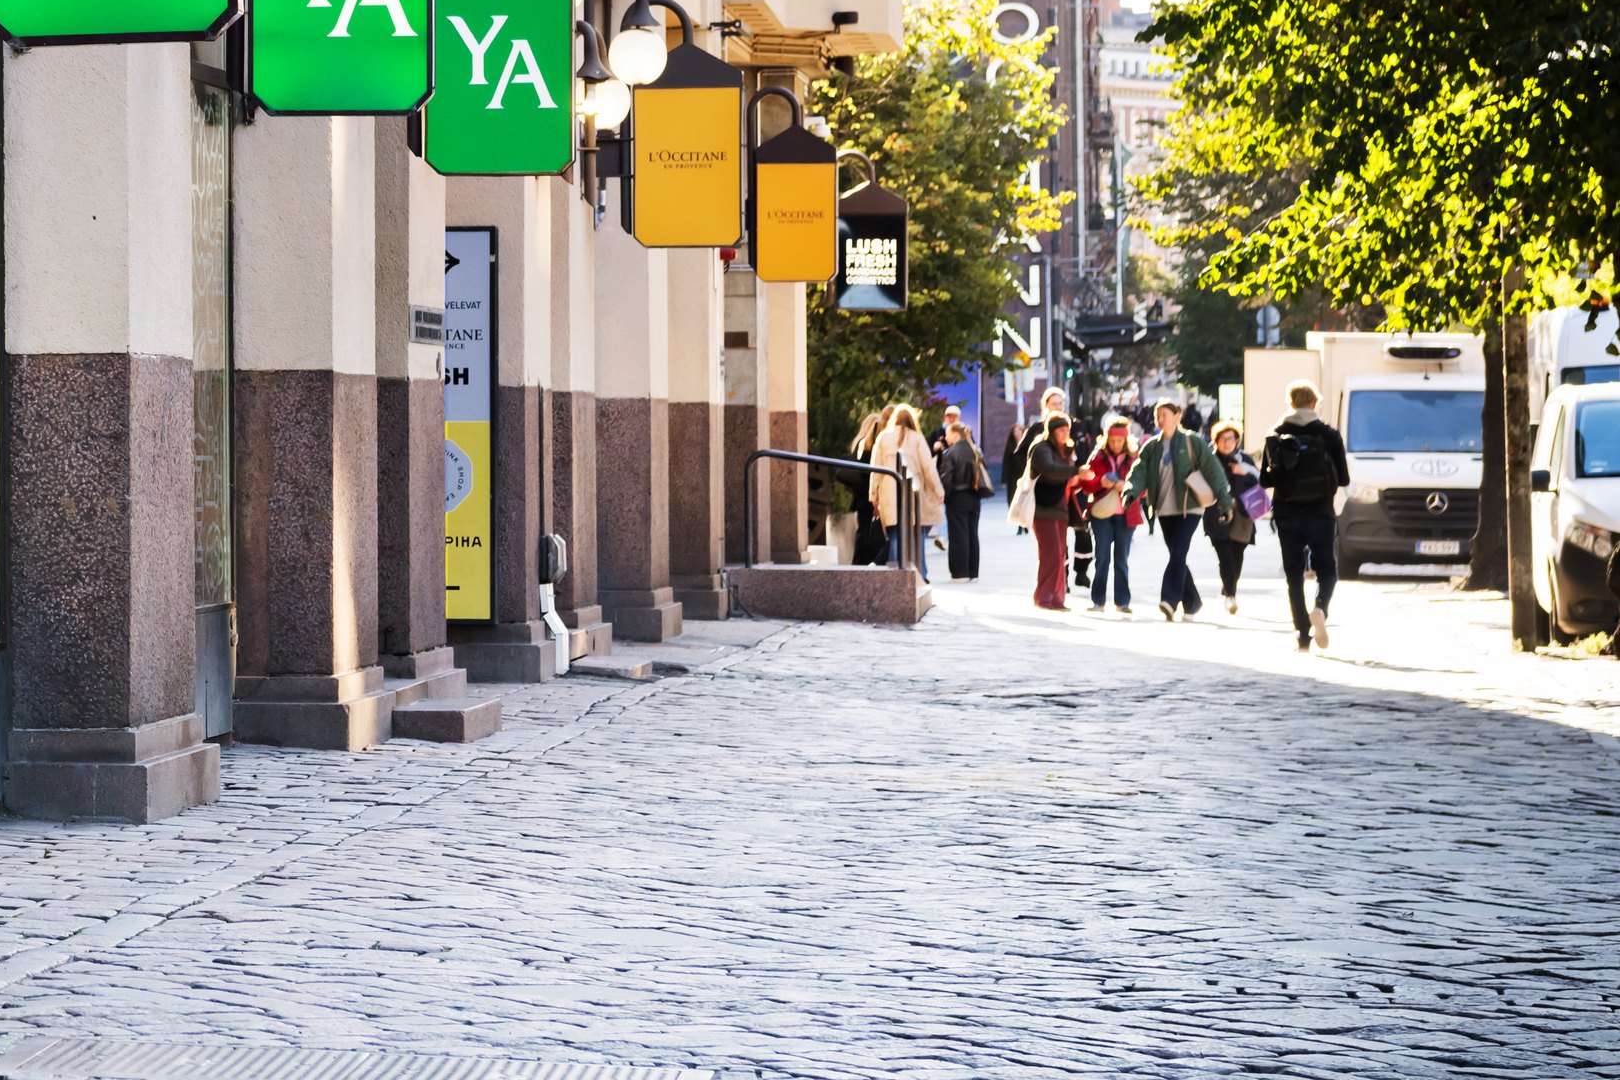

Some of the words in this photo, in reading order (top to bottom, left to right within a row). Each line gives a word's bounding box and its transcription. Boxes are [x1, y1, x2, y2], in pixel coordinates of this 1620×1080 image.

[446, 14, 559, 110] YA
[846, 238, 897, 254] LUSH
[846, 254, 897, 268] FRESH
